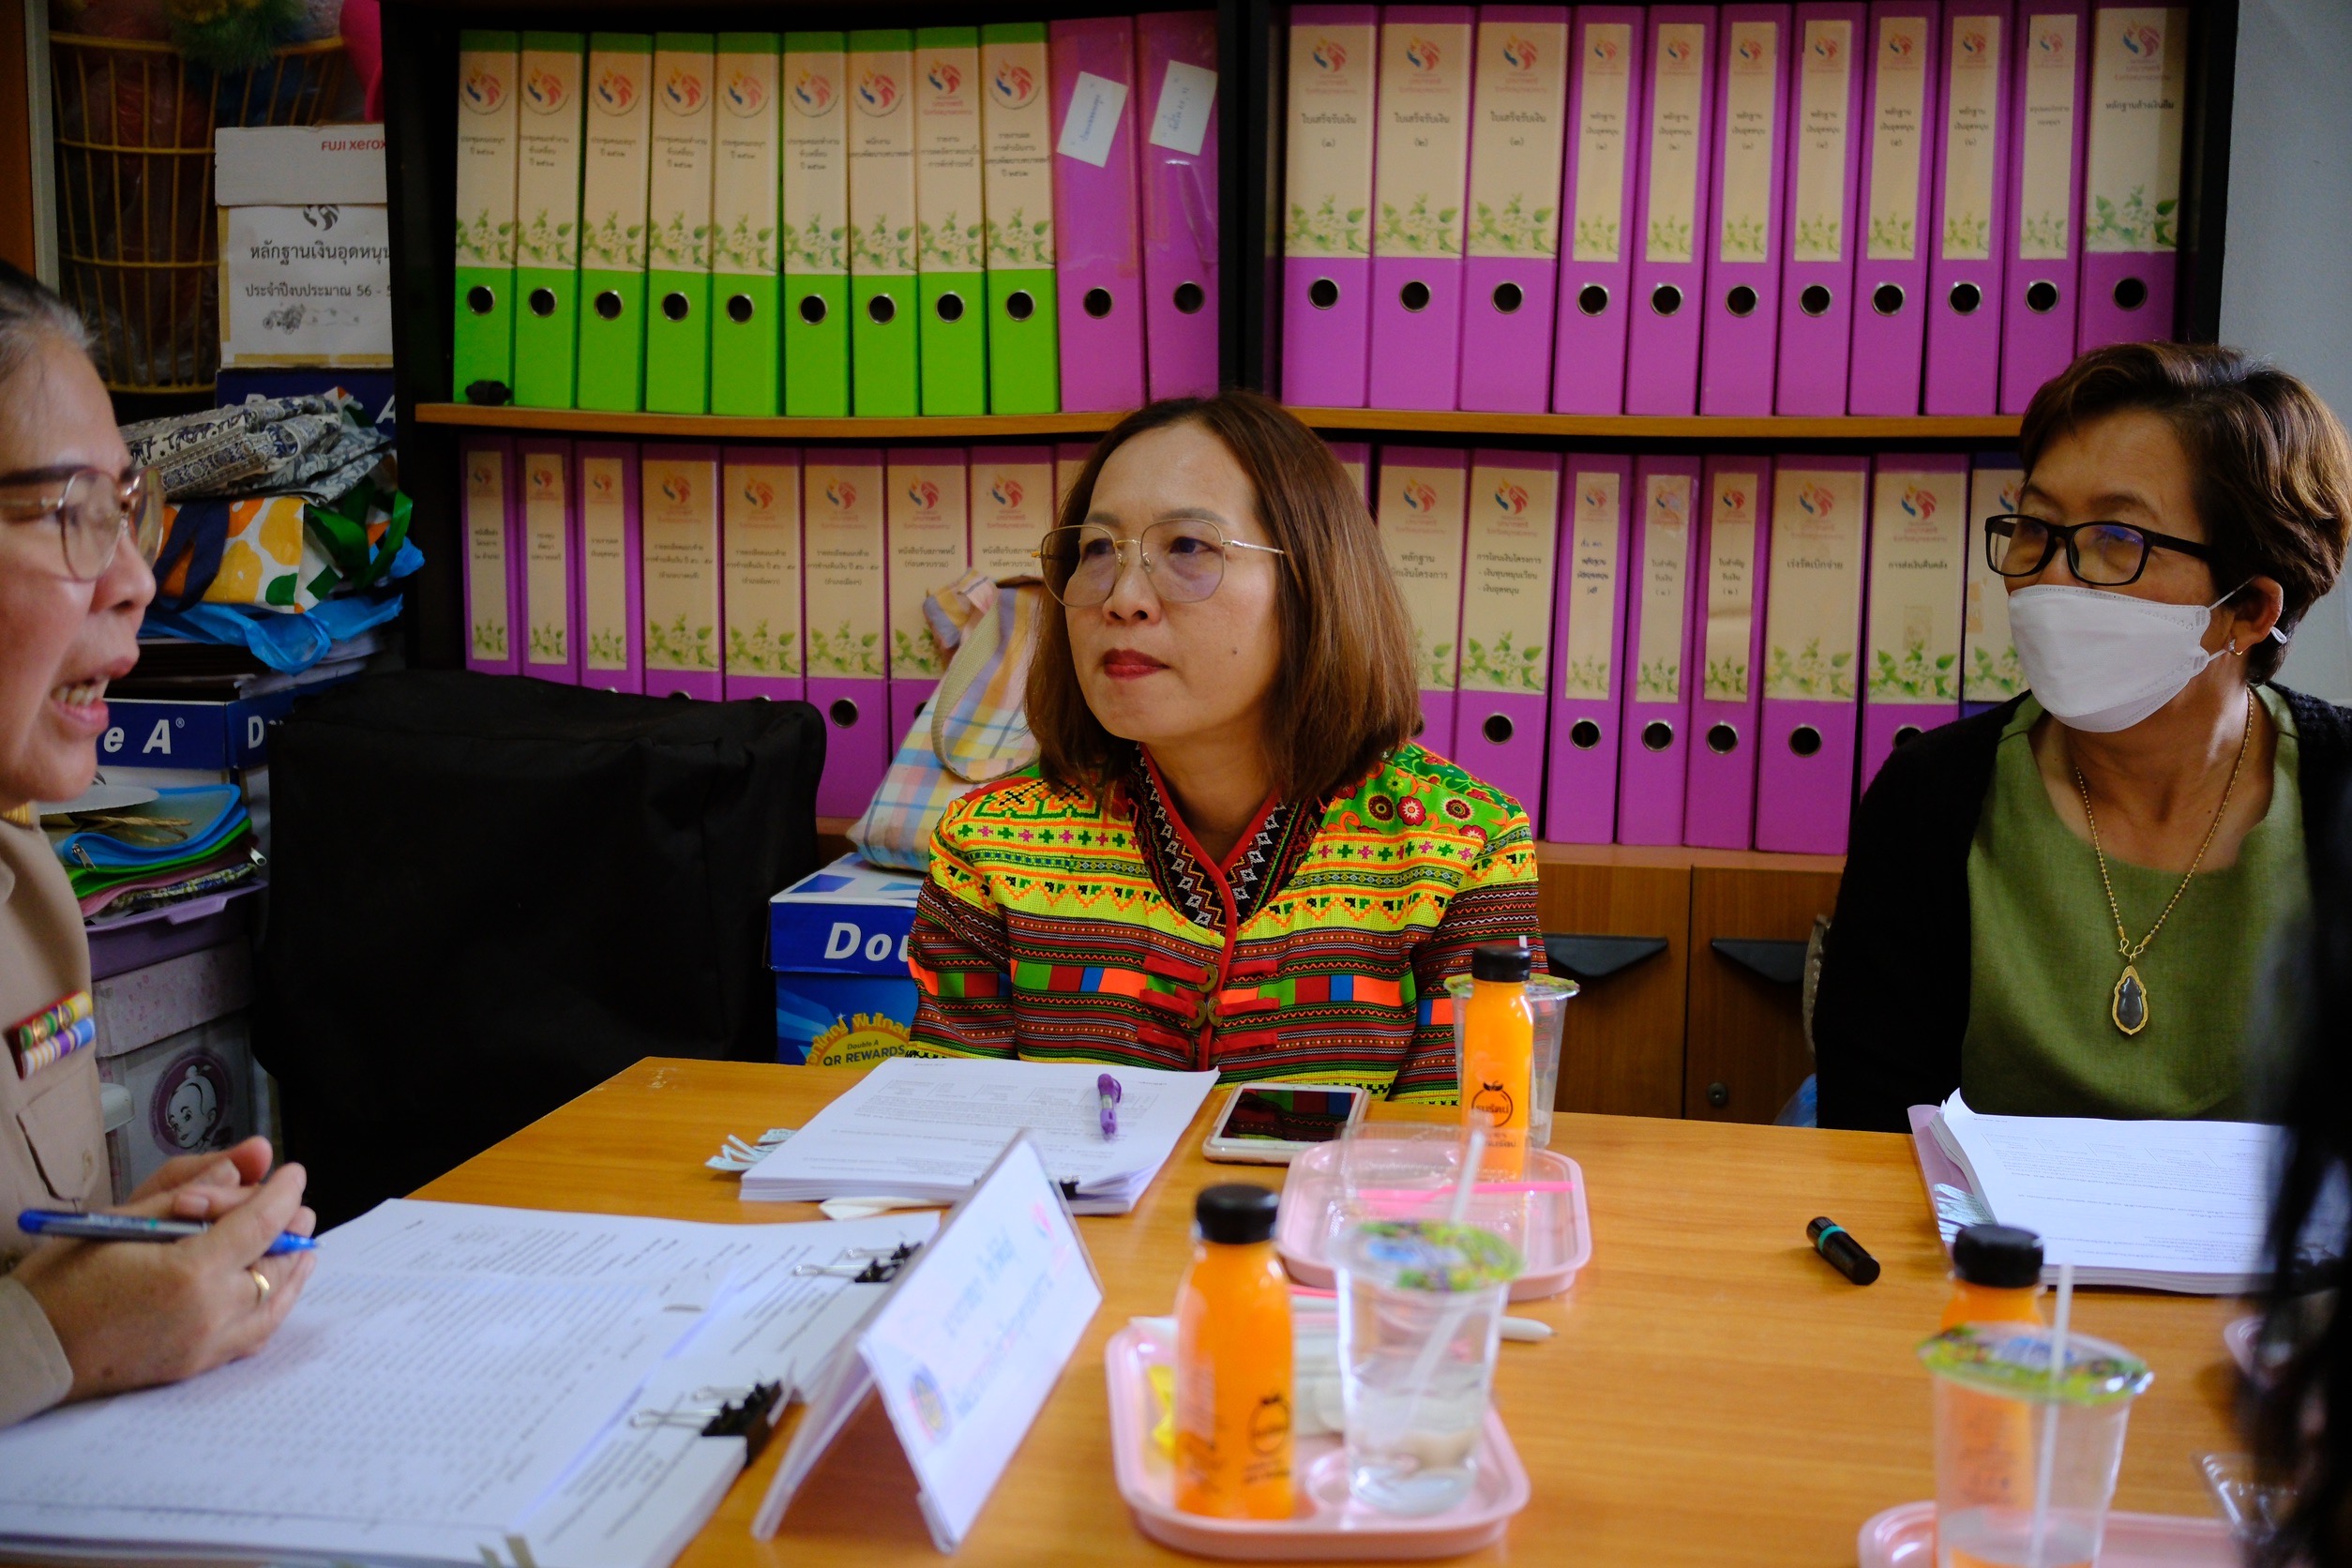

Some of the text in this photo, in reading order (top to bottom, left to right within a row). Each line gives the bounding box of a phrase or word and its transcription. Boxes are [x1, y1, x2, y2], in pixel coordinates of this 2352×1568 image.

[321, 138, 386, 151] FUJI xerox
[245, 282, 352, 297] ประจำปีงบประมาณ
[356, 284, 371, 296] 56
[897, 545, 956, 557] หนังสือรับสภาพหนี้
[1401, 551, 1436, 565] หลักฐาน
[1482, 583, 1520, 596] เงินอุดหนุน
[847, 1042, 873, 1050] Double
[822, 1045, 906, 1066] QR REWARDS
